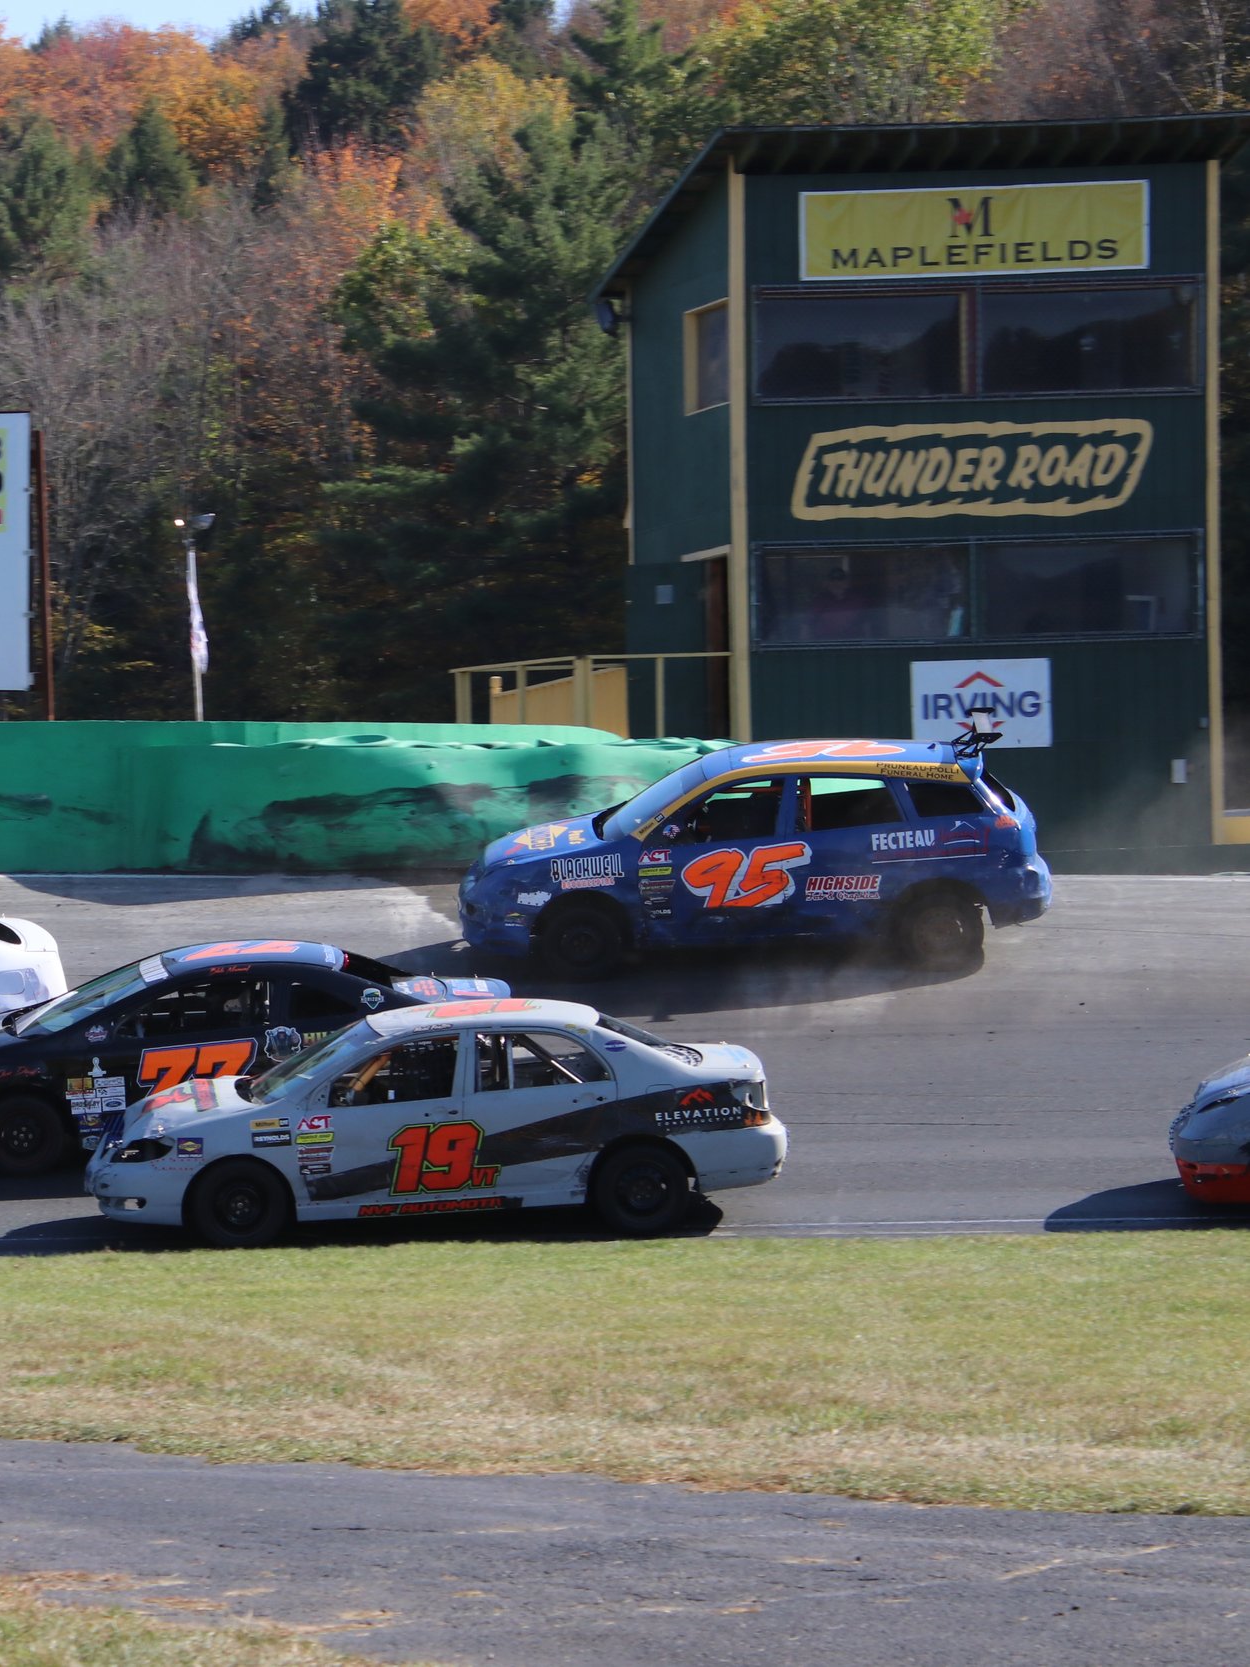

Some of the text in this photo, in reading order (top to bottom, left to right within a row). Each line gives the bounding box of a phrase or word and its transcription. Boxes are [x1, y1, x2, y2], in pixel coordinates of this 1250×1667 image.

[831, 238, 1119, 270] MAPLEFIELDS
[819, 443, 1128, 498] THUNDER ROAD
[922, 690, 1041, 720] IRVING
[876, 762, 959, 774] PRUNEAU-POLLI
[880, 769, 954, 781] FUNERAL HOME
[871, 829, 935, 851] FECTEAU
[638, 849, 672, 865] ACT
[550, 853, 625, 883] BLACKWELL
[682, 841, 813, 908] 95
[806, 875, 881, 891] HIGHSIDE
[137, 1037, 258, 1098] 77
[297, 1114, 333, 1129] ACT
[654, 1106, 742, 1121] ELEVATION
[656, 1115, 743, 1127] CONSTRUCTION
[254, 1134, 290, 1142] REYNOLDS
[387, 1121, 500, 1196] 19 VT
[359, 1204, 398, 1217] NVF
